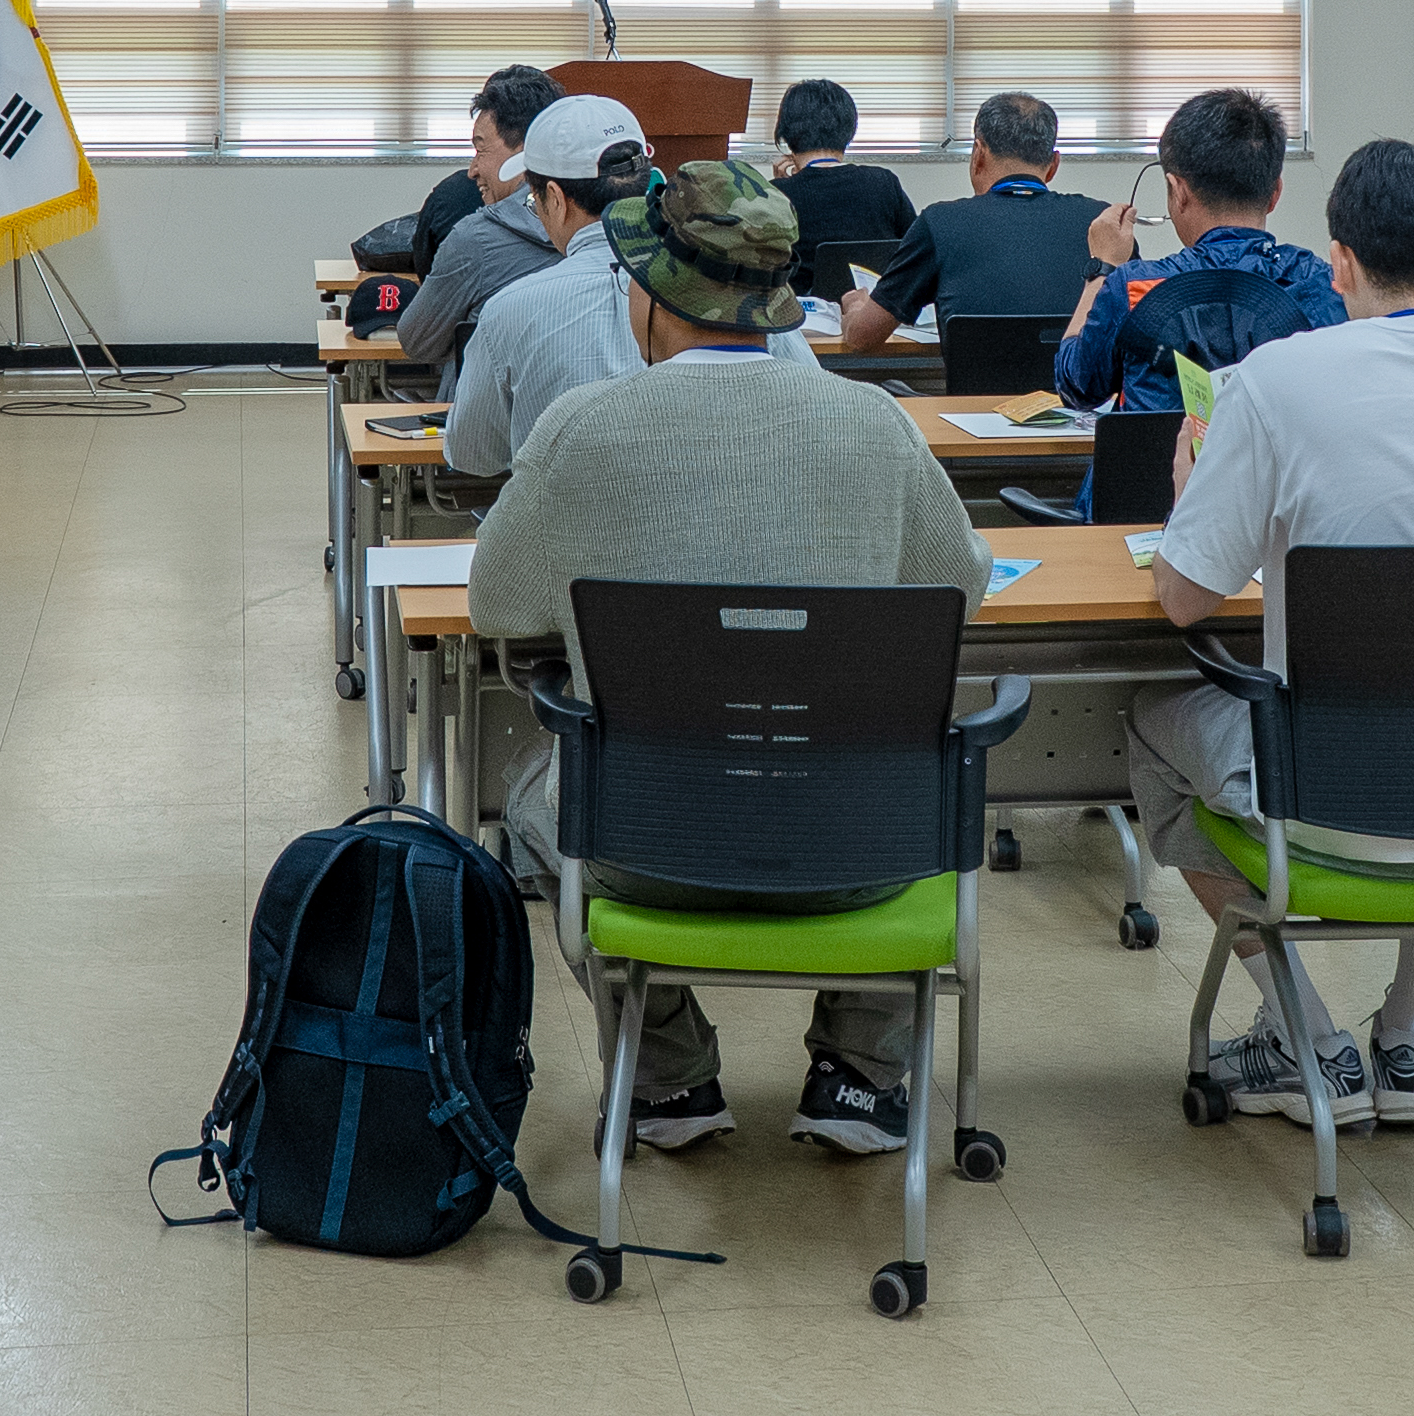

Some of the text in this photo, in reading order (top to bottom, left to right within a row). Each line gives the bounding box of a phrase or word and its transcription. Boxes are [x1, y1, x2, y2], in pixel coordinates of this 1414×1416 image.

[603, 124, 625, 136] POLO
[375, 284, 400, 312] B
[835, 1084, 877, 1113] HOKA
